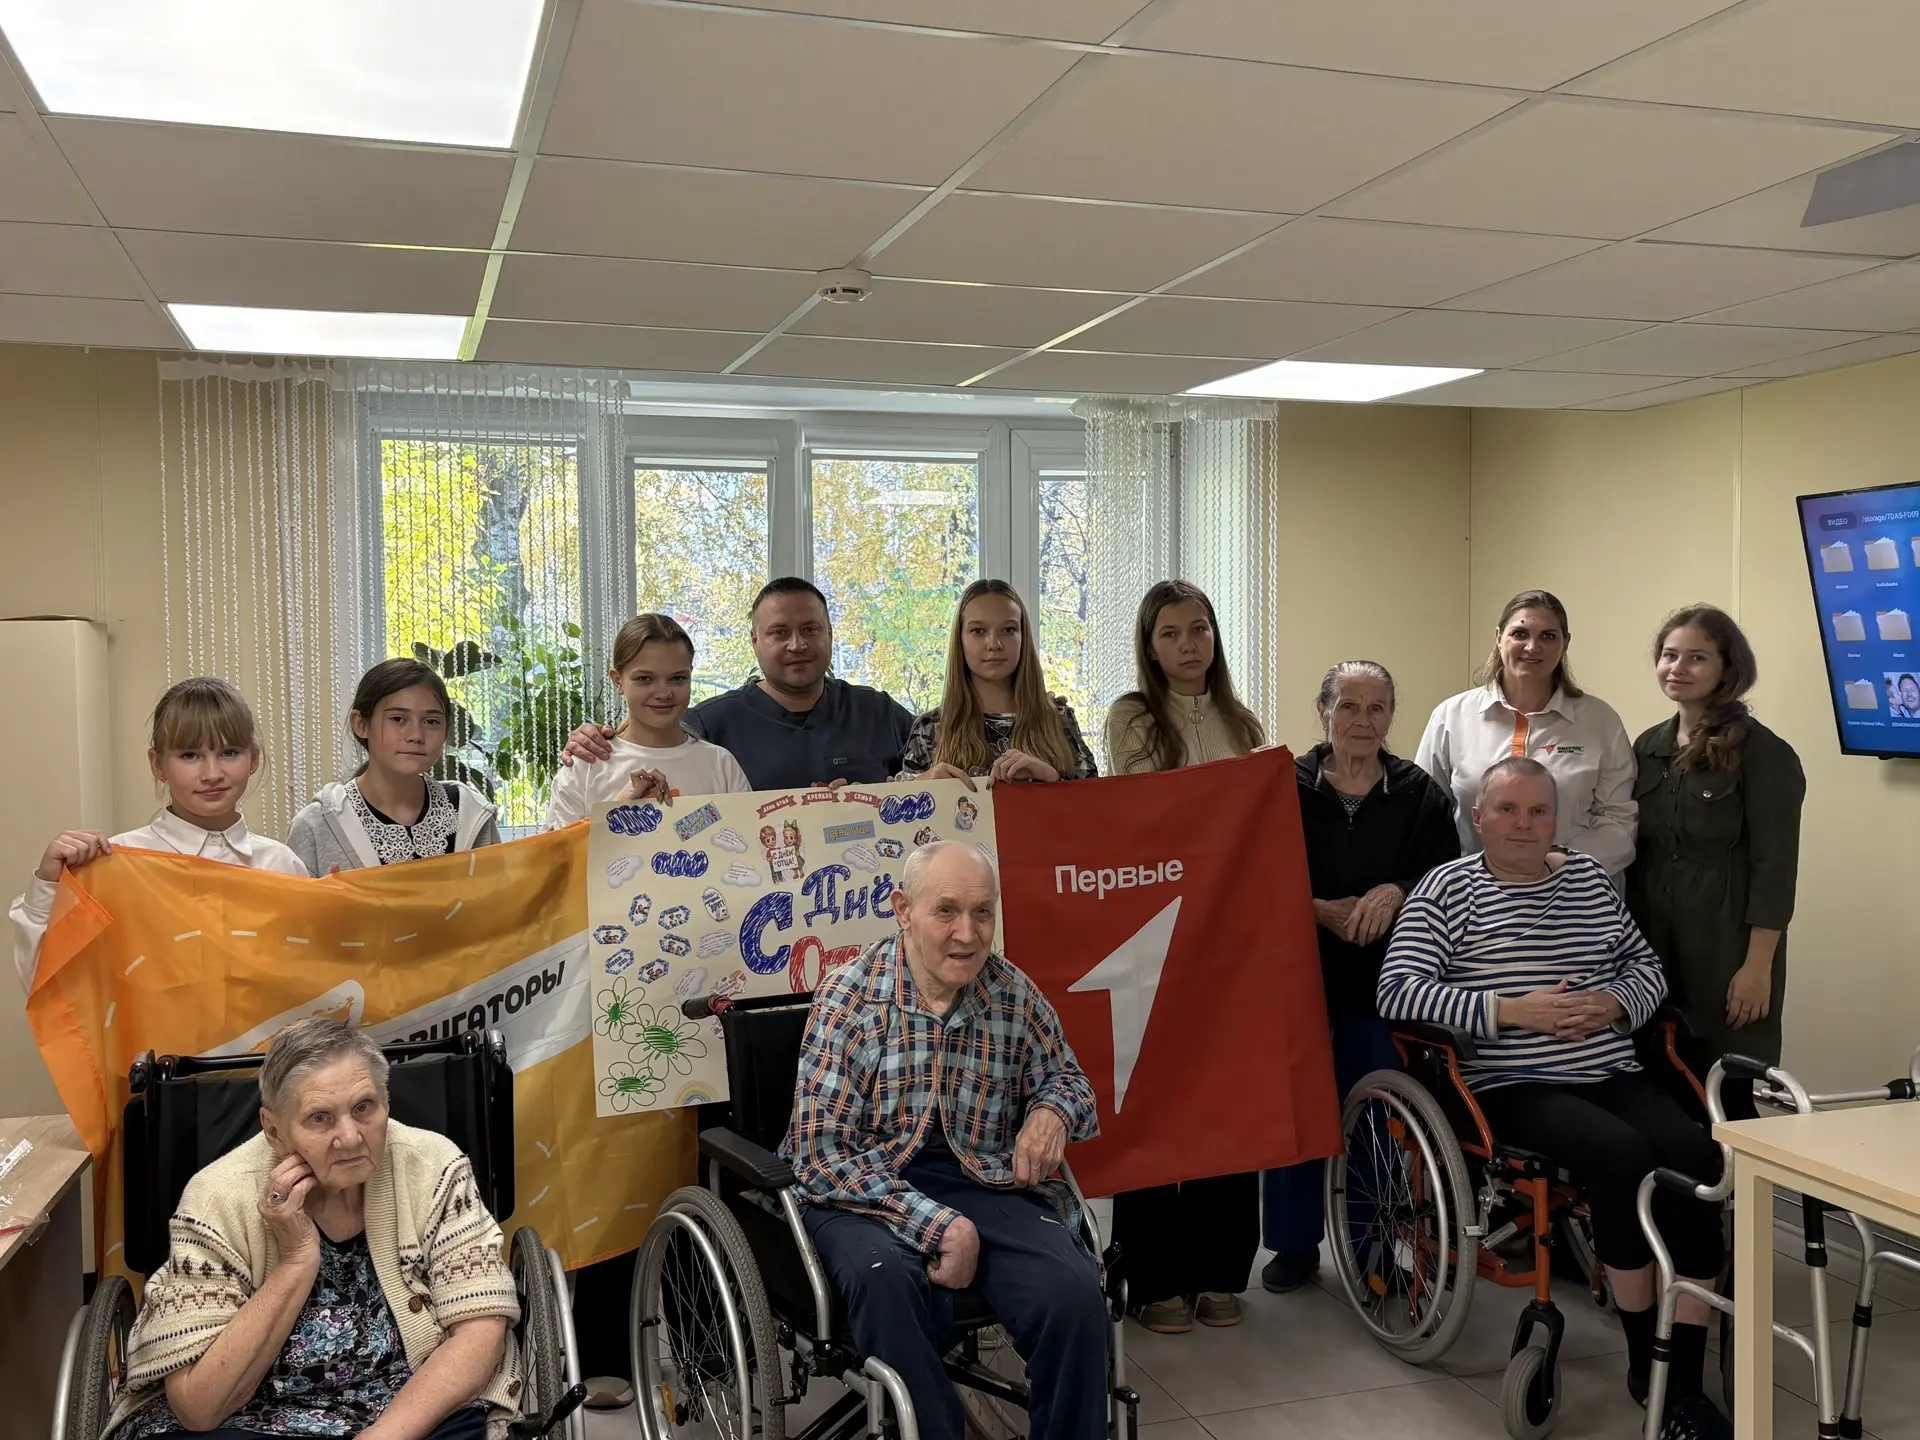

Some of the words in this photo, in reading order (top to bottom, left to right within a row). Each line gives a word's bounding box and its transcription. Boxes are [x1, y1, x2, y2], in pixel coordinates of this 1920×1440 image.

[1827, 518, 1848, 526] ВИДЕО
[829, 829, 849, 840] ДЕНЬ
[849, 825, 871, 836] ОТЦА
[1054, 858, 1184, 900] Первые
[801, 864, 903, 928] Днё
